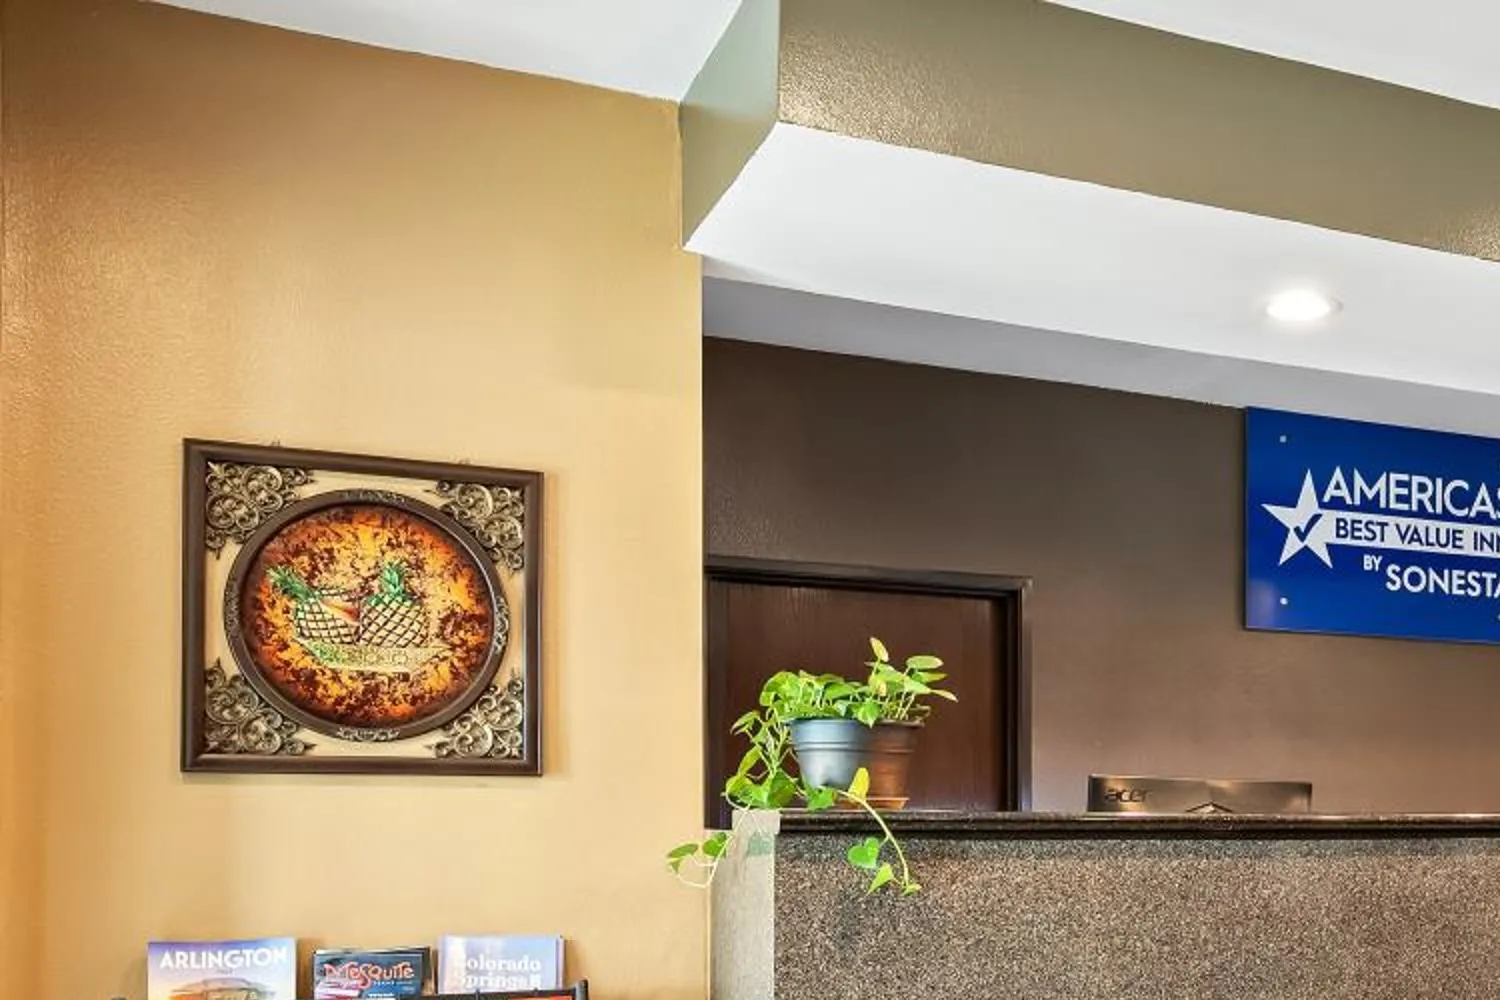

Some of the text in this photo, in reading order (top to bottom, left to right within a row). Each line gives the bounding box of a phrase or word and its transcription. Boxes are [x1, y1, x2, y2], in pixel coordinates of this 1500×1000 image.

[1335, 516, 1389, 543] BEST
[1396, 523, 1464, 549] VALUE
[1363, 554, 1382, 571] BY
[159, 947, 288, 969] ARLINGTON
[454, 953, 542, 972] olorado
